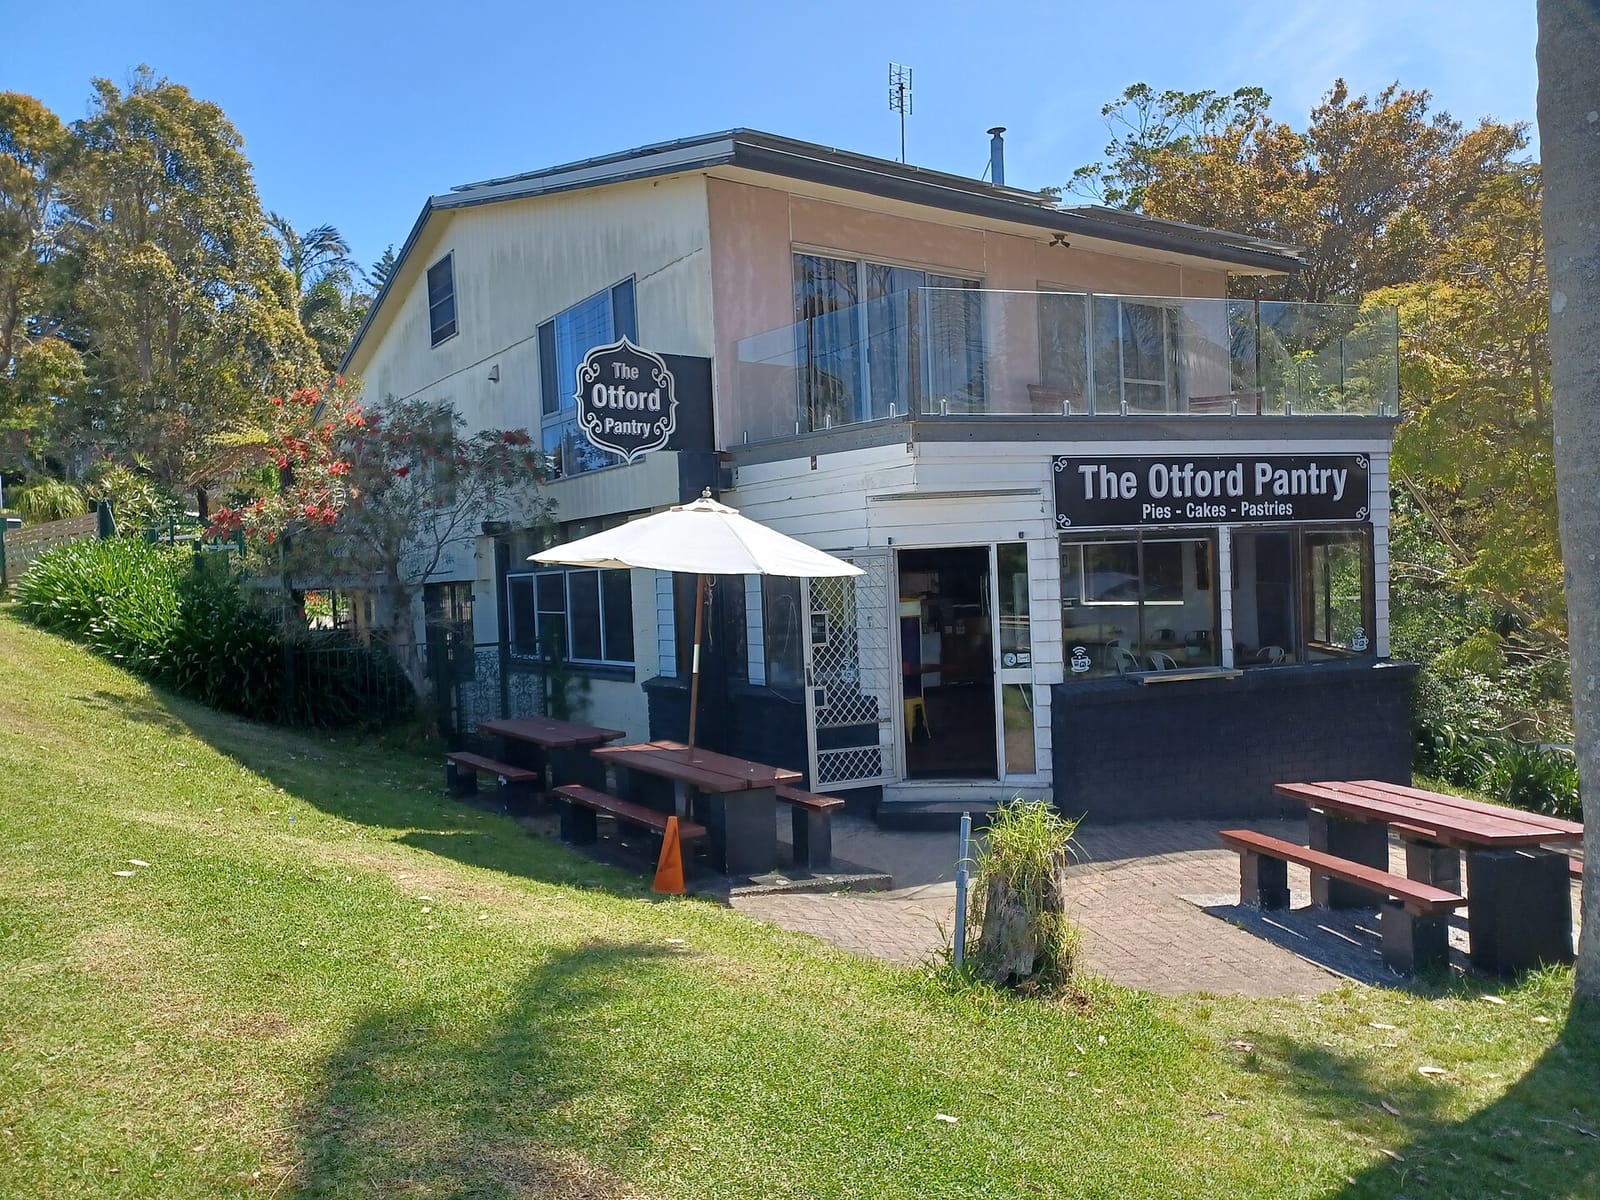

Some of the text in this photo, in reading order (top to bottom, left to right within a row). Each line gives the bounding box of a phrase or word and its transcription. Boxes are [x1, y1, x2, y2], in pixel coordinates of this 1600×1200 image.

[612, 362, 640, 380] The
[591, 383, 661, 412] Otford
[604, 418, 651, 439] Pantry
[1078, 462, 1347, 501] The Otford Pantry
[1142, 503, 1171, 519] Pies
[1186, 502, 1226, 518] Cakes
[1241, 501, 1293, 517] Pastries
